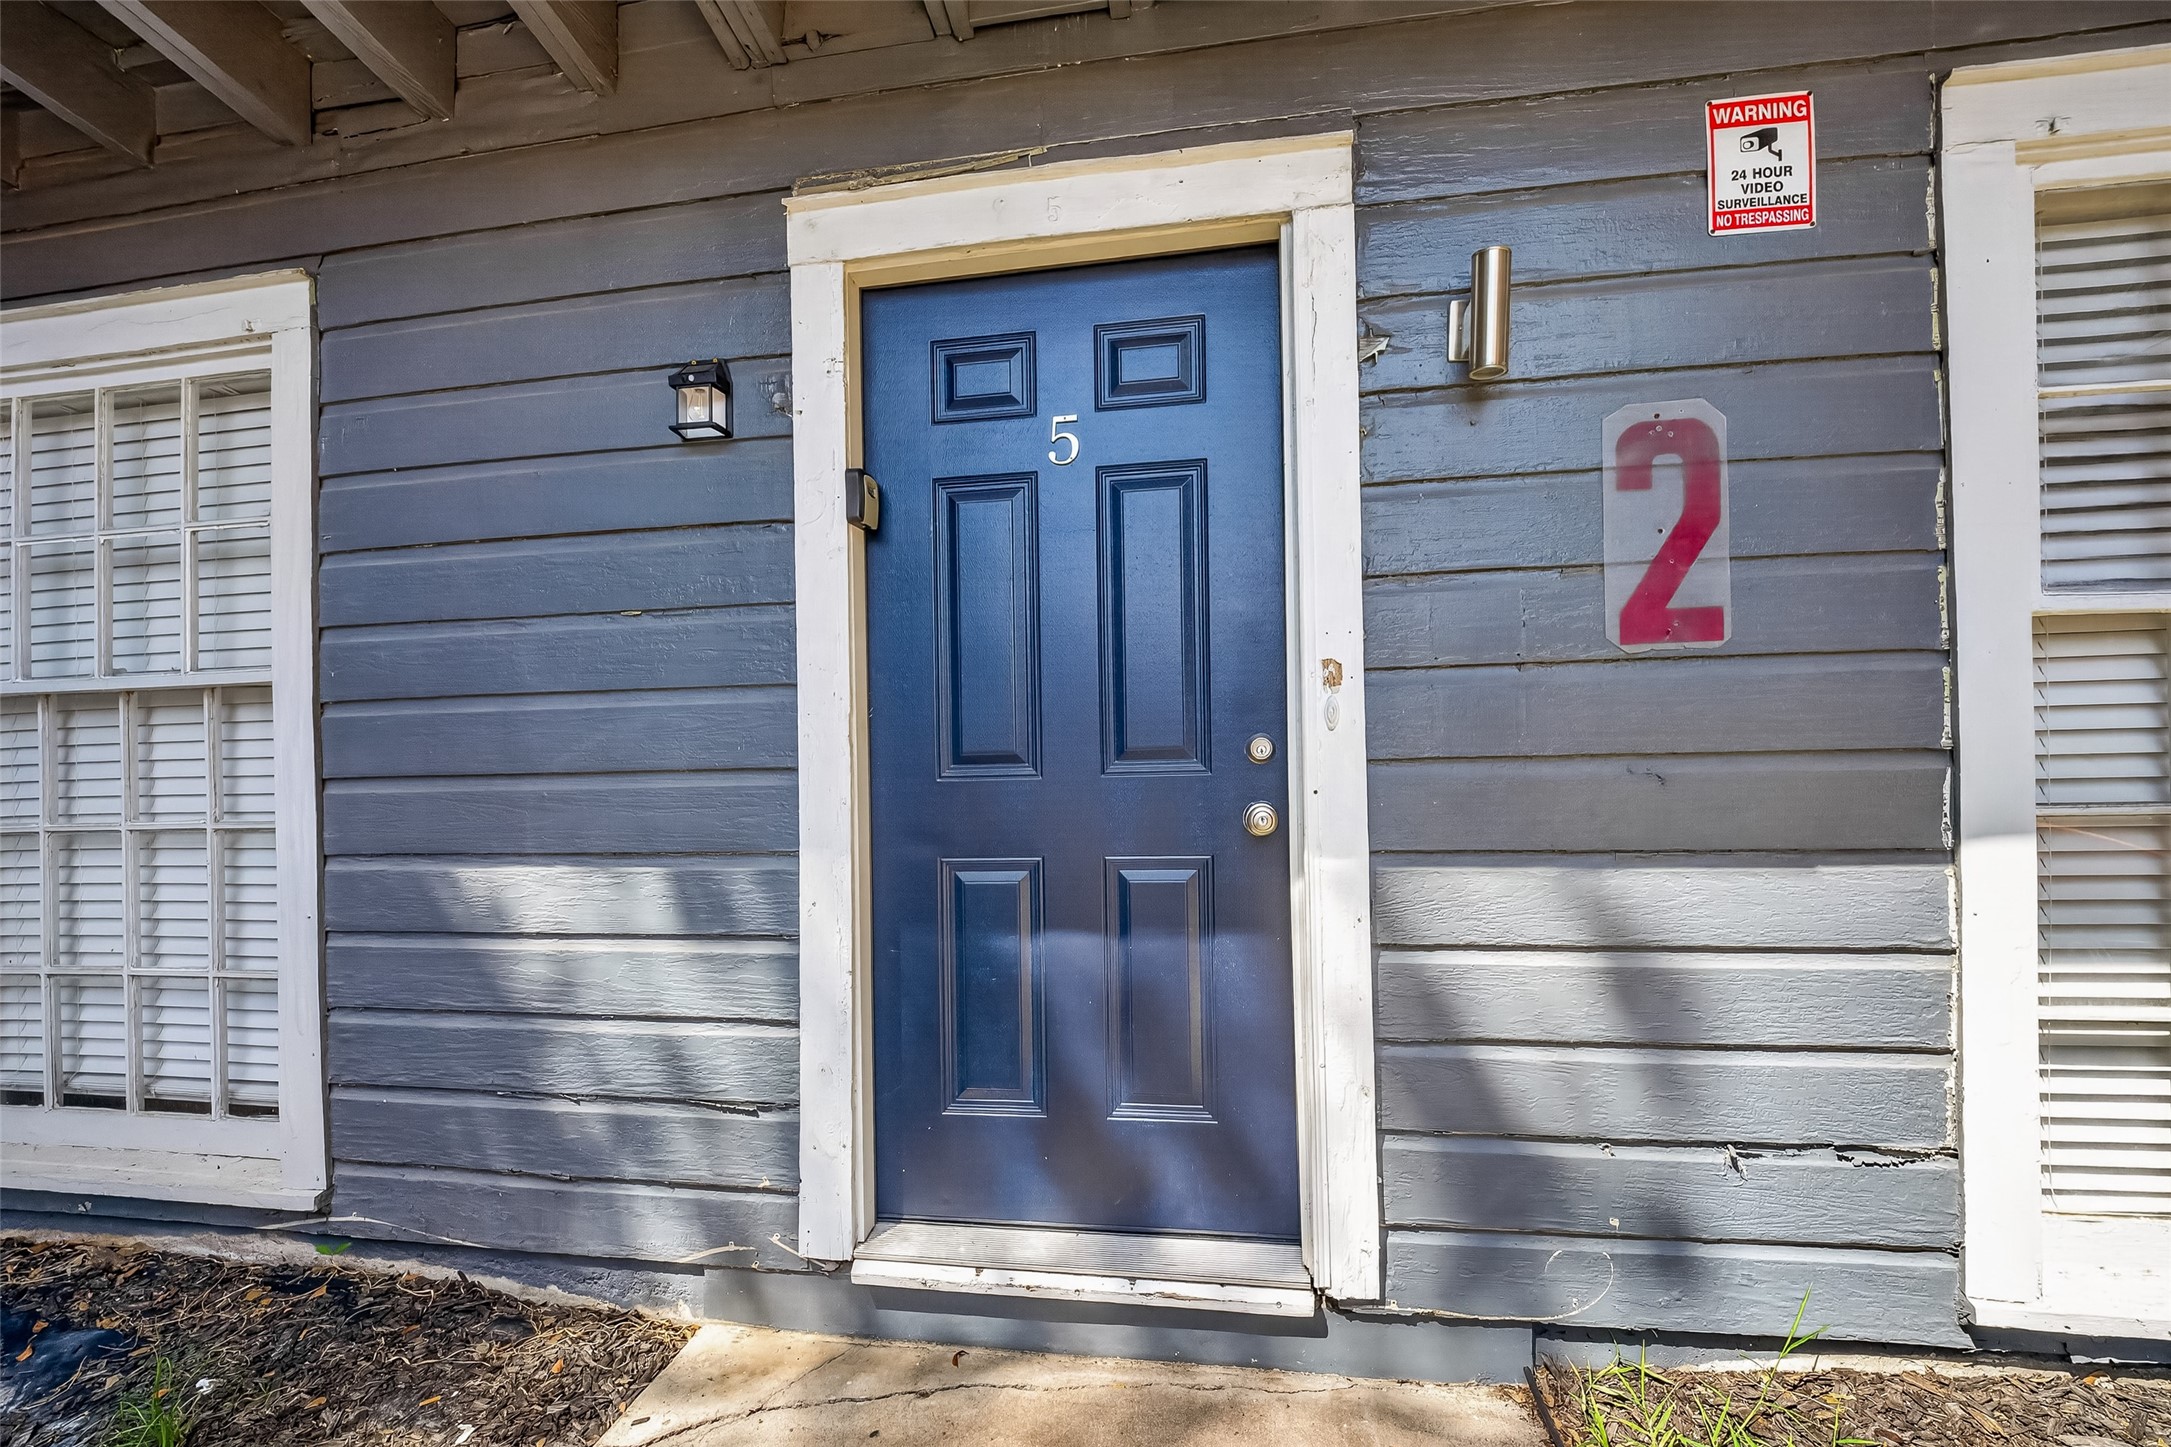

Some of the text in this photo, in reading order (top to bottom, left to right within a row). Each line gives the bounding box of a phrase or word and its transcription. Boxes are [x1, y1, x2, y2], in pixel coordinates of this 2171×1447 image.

[1712, 99, 1808, 125] WARNING
[1731, 165, 1793, 181] 24 HOUR
[1740, 180, 1784, 195] VIDEO
[1717, 193, 1808, 210] SURVEILLANCE
[1716, 207, 1809, 227] NO TRESPASSING
[1048, 413, 1080, 466] 5
[1615, 417, 1724, 646] 2
